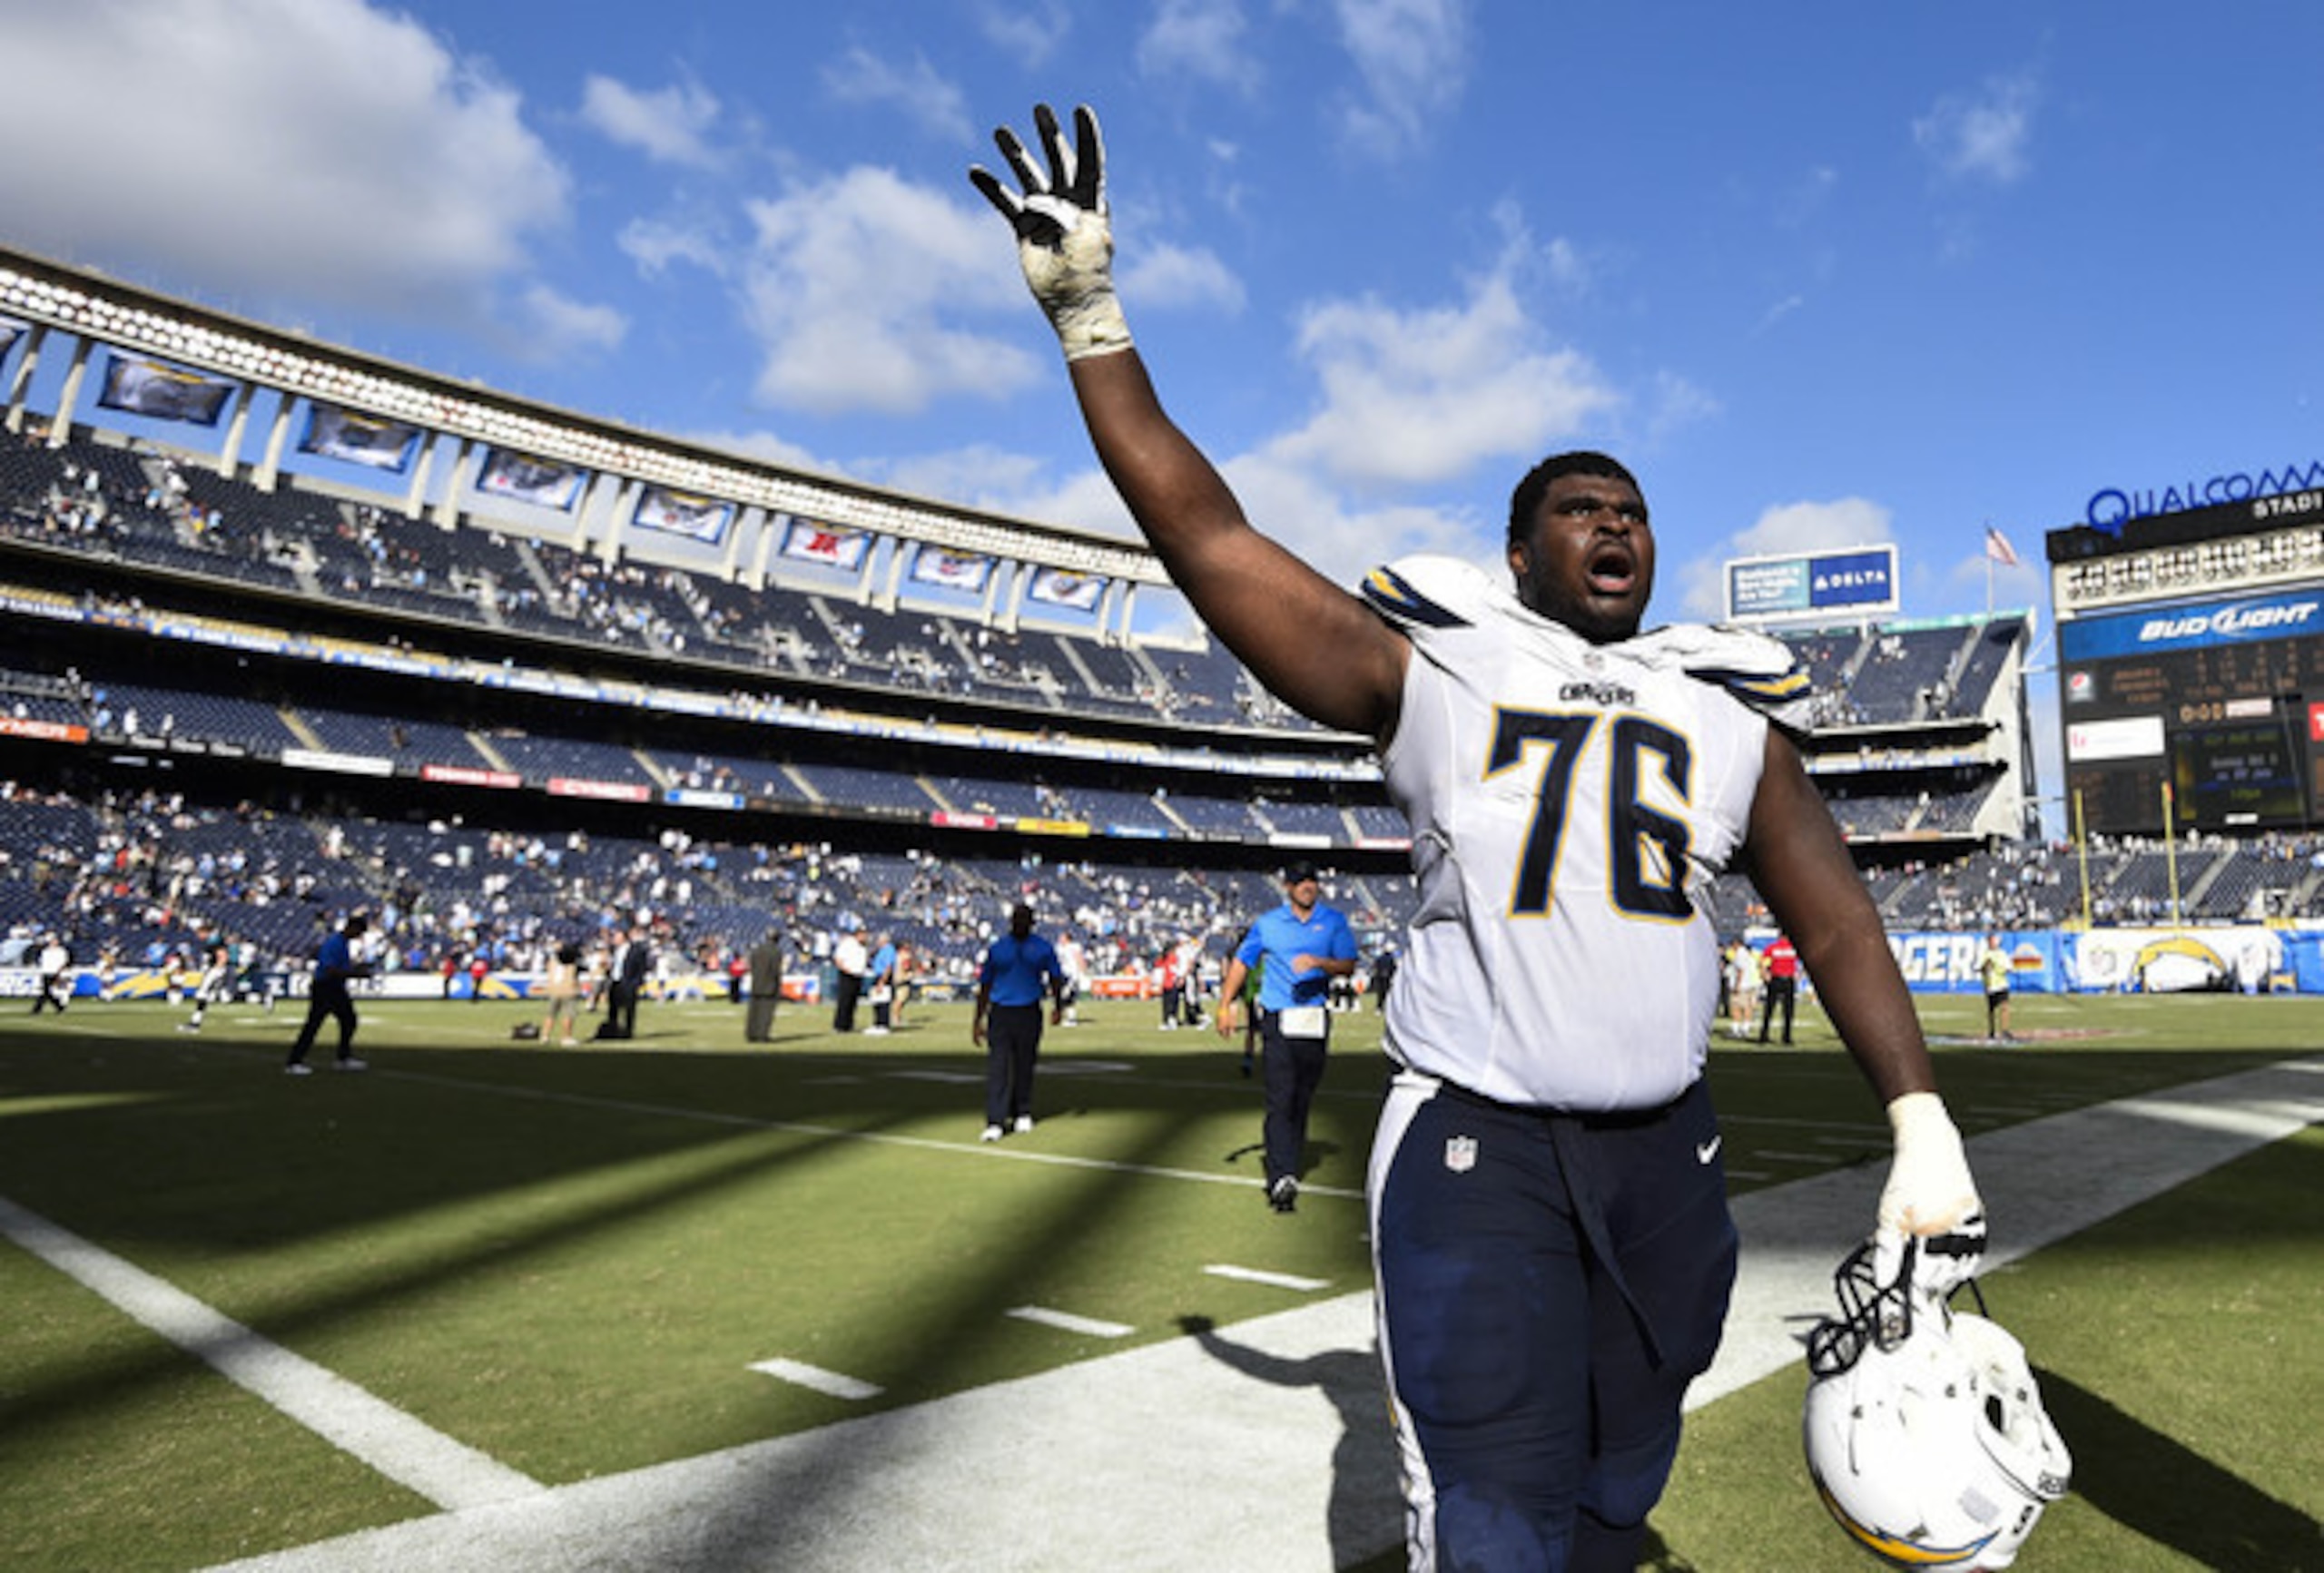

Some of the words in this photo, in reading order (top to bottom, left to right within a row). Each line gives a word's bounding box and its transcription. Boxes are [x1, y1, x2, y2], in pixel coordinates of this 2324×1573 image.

[1830, 570, 1886, 588] DELTA
[2139, 615, 2210, 641] BUD
[2216, 602, 2319, 634] LIGHT
[1481, 702, 1696, 926] 76
